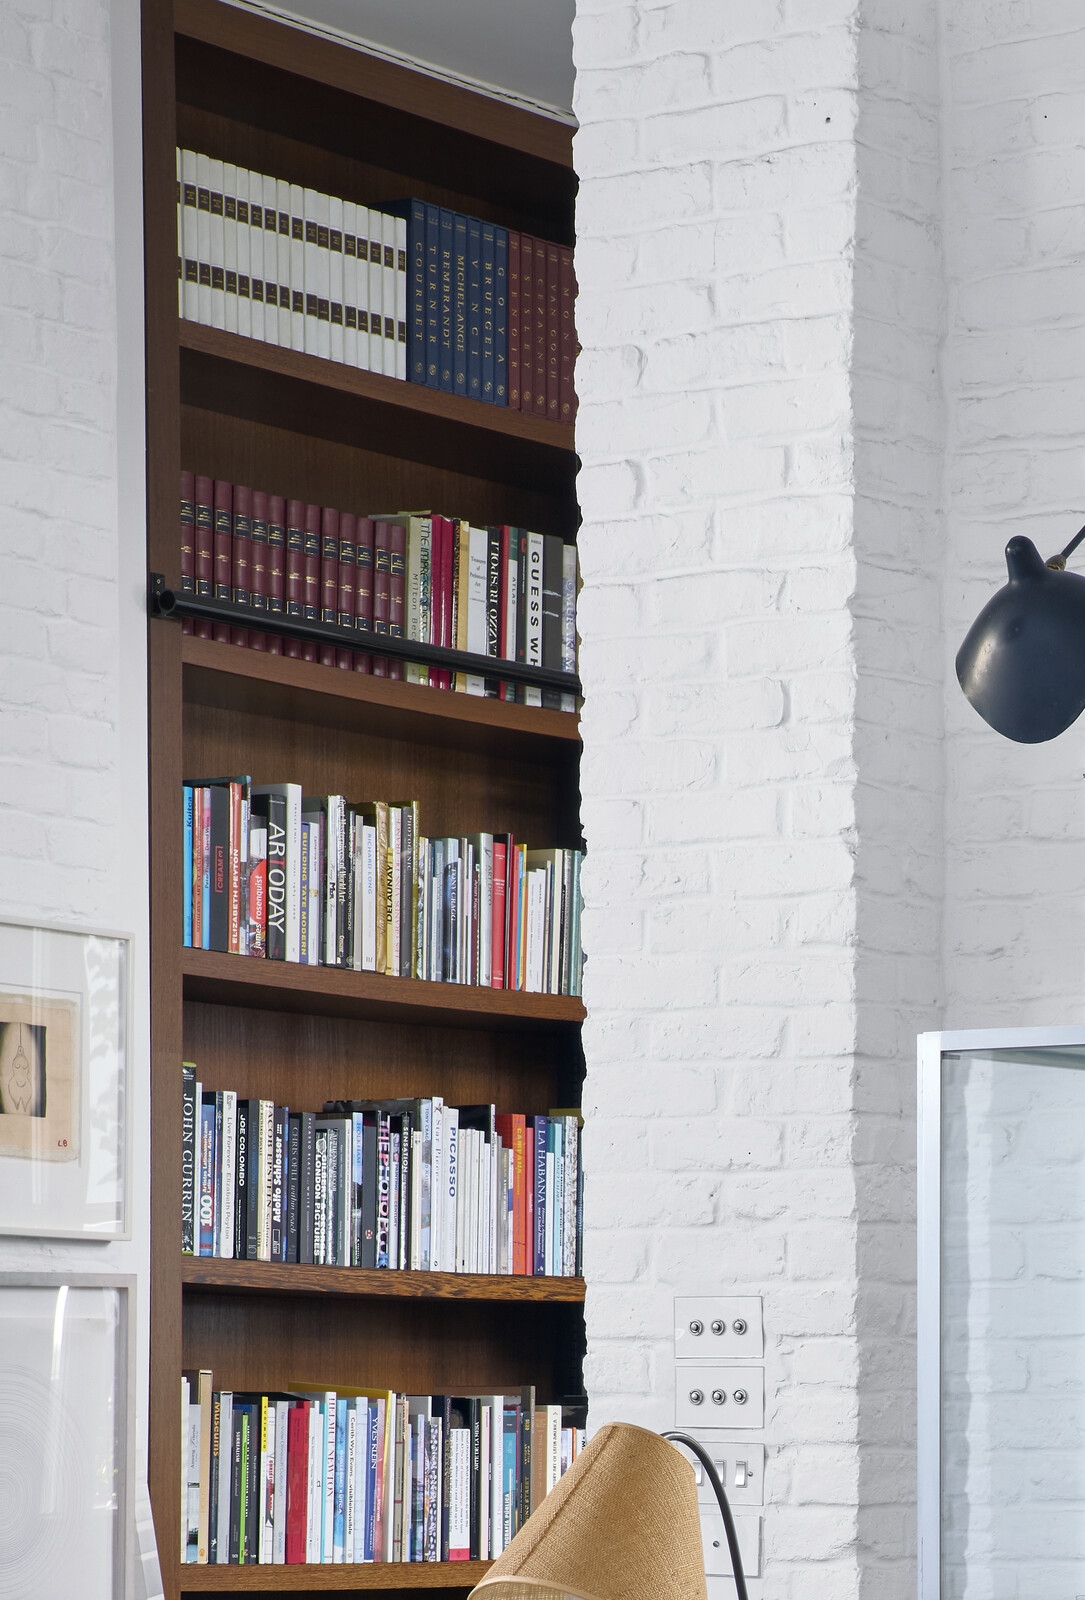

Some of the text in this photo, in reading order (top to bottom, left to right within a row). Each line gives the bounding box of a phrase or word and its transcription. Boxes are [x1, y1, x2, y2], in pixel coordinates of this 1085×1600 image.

[488, 540, 499, 603] RUSPOLI
[531, 552, 540, 666] GUESS WH
[254, 876, 263, 949] james rosenquist
[268, 822, 285, 934] ARTODAY
[182, 1093, 192, 1223] JOHN CURRIN
[538, 1130, 545, 1145] LA
[200, 1195, 213, 1227] 100
[273, 1137, 282, 1222] Adolfo Schlosser
